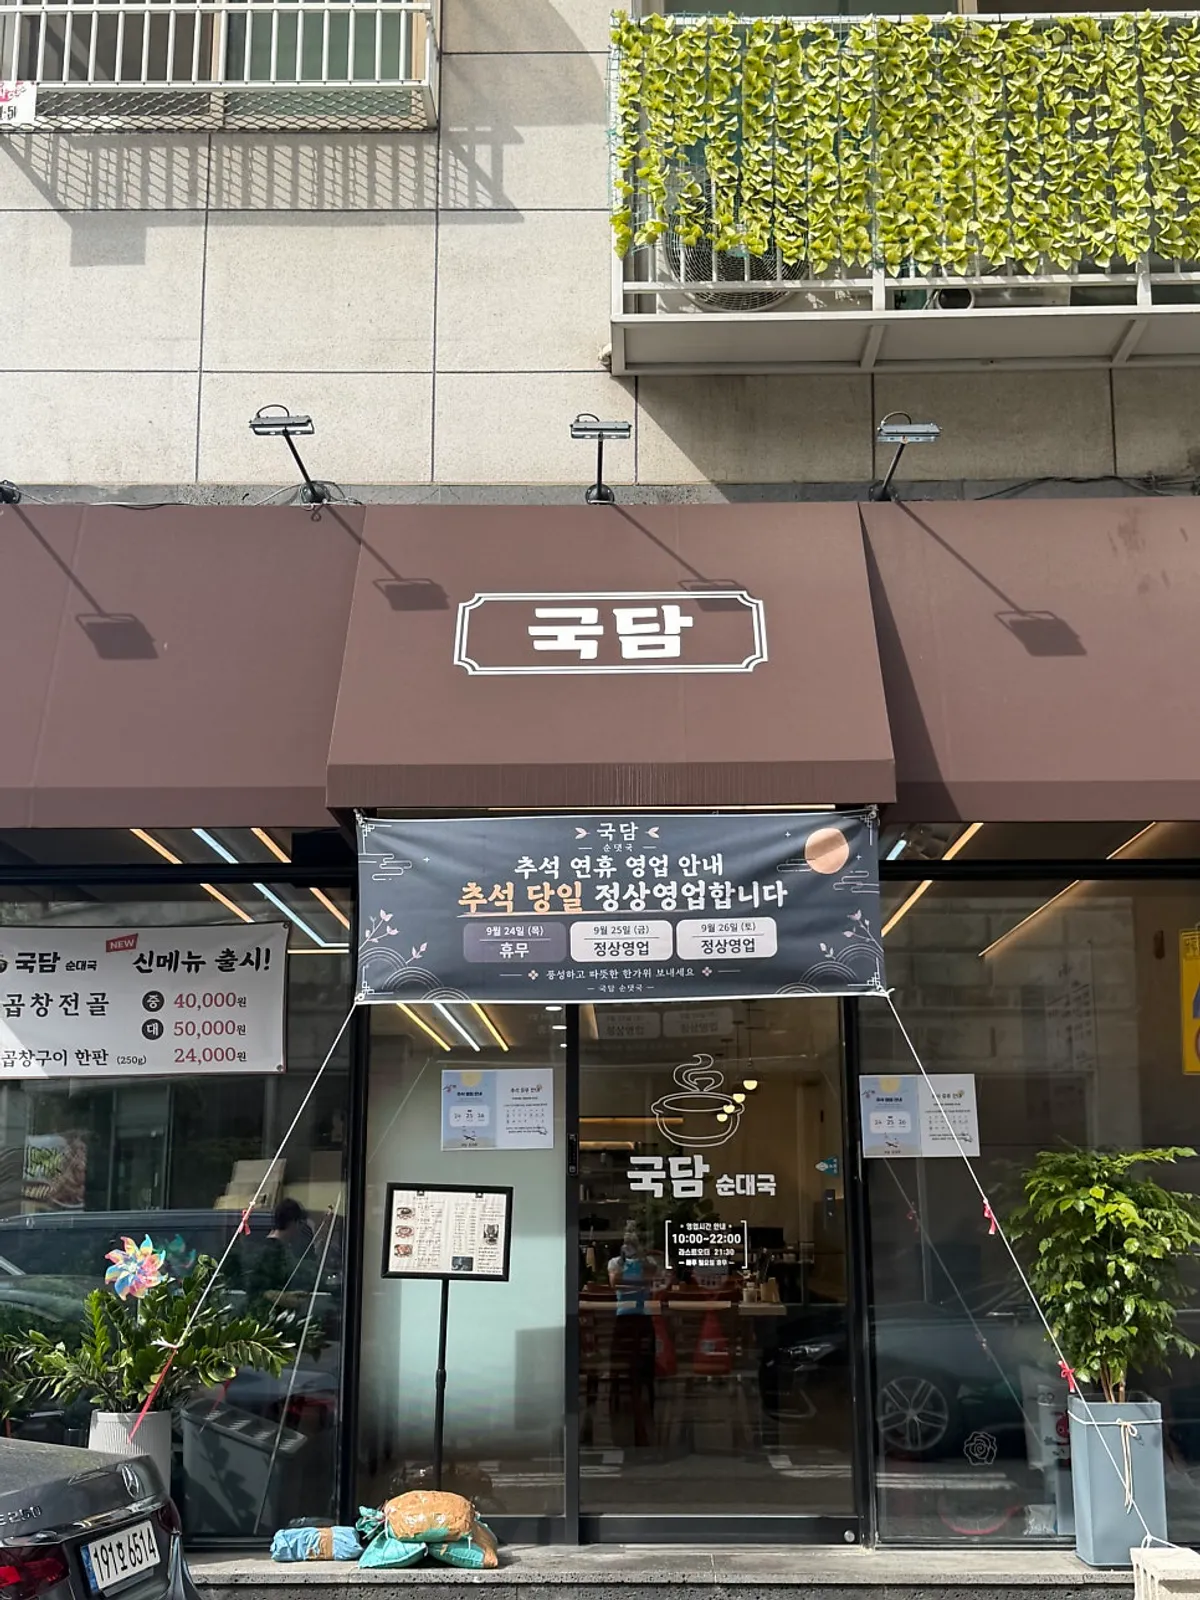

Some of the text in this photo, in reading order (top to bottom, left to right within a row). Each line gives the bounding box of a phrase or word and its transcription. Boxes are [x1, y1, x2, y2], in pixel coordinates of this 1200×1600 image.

[528, 605, 693, 659] 국담
[596, 821, 639, 841] 국담
[603, 843, 633, 852] 순댓국
[514, 853, 723, 880] 추석 연휴 영업 안내
[457, 880, 788, 913] 추석 당일 정상영업합니다
[486, 925, 544, 937] 9월 24일 (목)
[593, 925, 650, 935] 9월 25일 (금)
[701, 921, 756, 932] 9월 26일 (토)
[109, 938, 136, 950] NEW
[500, 942, 529, 958] 휴무
[593, 940, 649, 956] 정상영업
[701, 938, 756, 954] 정상영업
[15, 952, 97, 973] 국담 순대국
[132, 947, 271, 974] 신메뉴 출시!
[546, 966, 695, 980] 풍성하고 따뜻한 한가위 보내세요
[174, 992, 247, 1011] 40,000원
[174, 1020, 246, 1039] 50,000원
[1, 1049, 147, 1068] 곱창구이 한판 (250g)
[174, 1047, 247, 1067] 24,000원
[627, 1154, 777, 1198] 국담 순대국
[686, 1222, 727, 1231] 영업시간 안내
[672, 1233, 741, 1244] 10:00~22:00
[678, 1248, 735, 1256] 라스트오더 21:30
